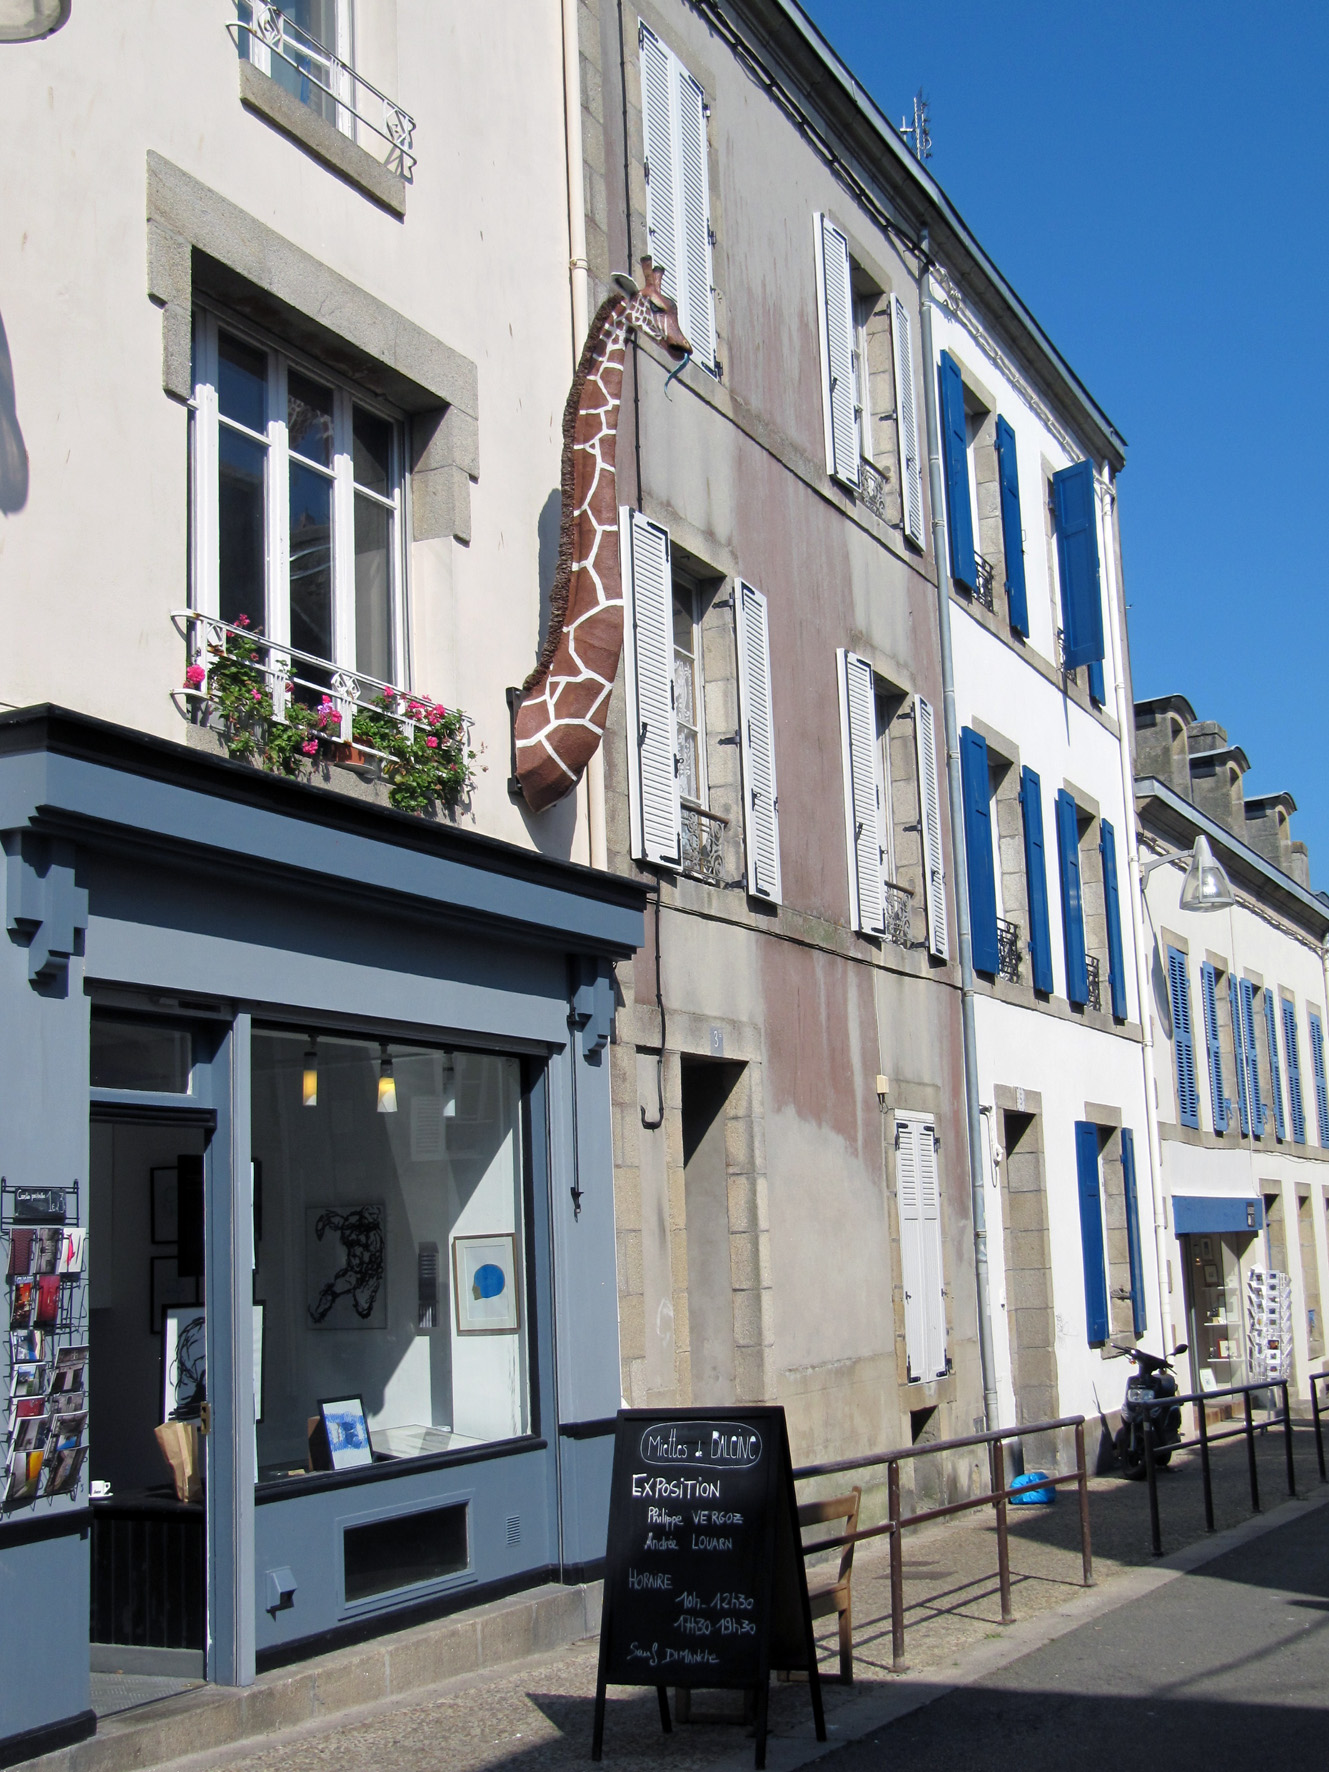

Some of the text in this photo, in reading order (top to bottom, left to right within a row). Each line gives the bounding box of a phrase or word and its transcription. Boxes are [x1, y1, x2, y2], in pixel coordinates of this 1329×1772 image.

[648, 1427, 688, 1459] Miettes
[694, 1440, 703, 1458] de
[647, 1506, 744, 1531] Philippe VERGOZ
[691, 1533, 733, 1550] LOUARN
[626, 1641, 658, 1666] Sauf
